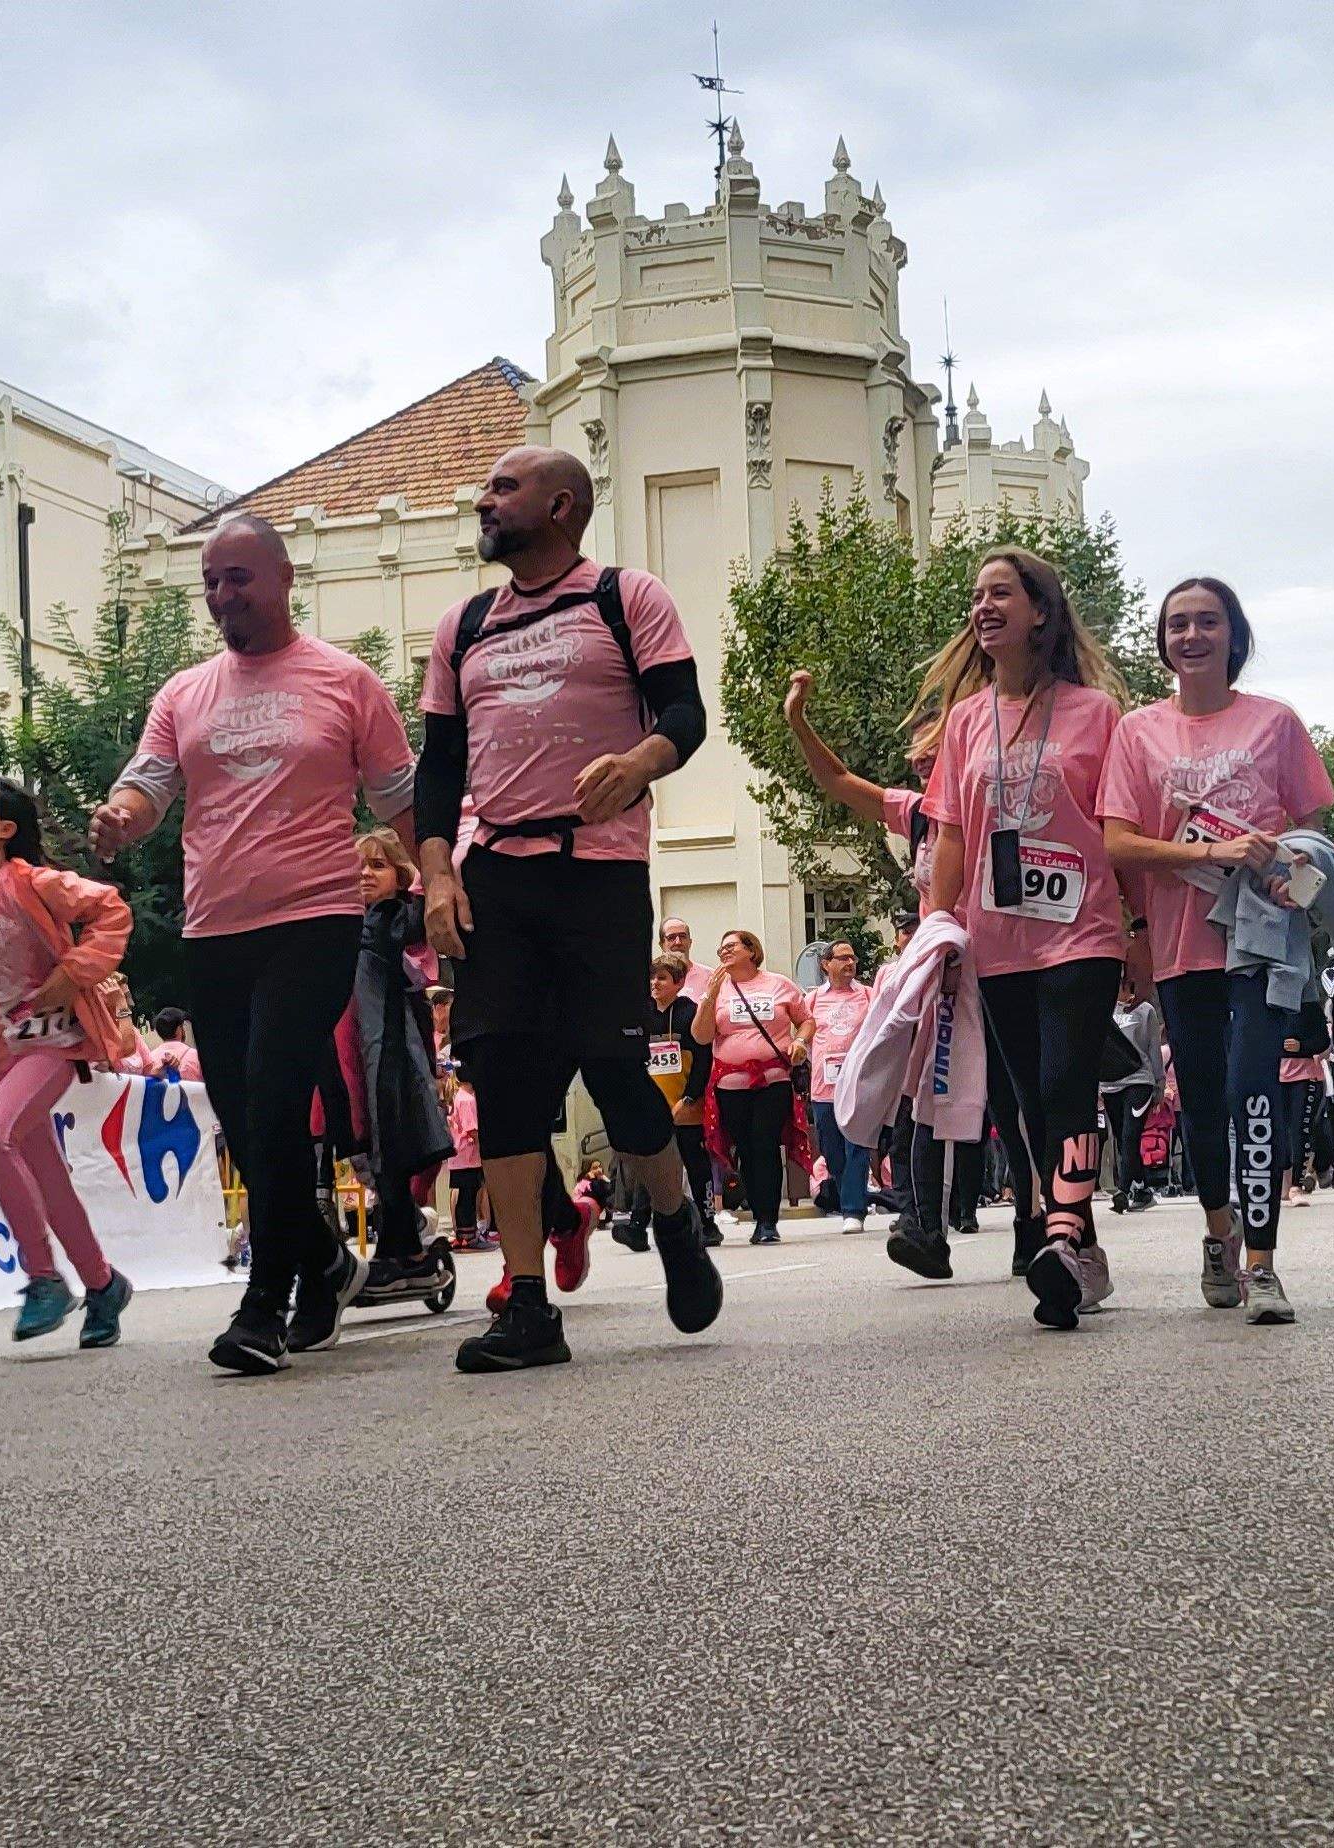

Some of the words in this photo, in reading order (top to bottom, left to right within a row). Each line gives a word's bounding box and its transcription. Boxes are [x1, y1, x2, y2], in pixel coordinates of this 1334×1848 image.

[1302, 1078, 1317, 1134] ARMOU
[1063, 1132, 1099, 1175] NI
[1242, 1094, 1273, 1228] adidas
